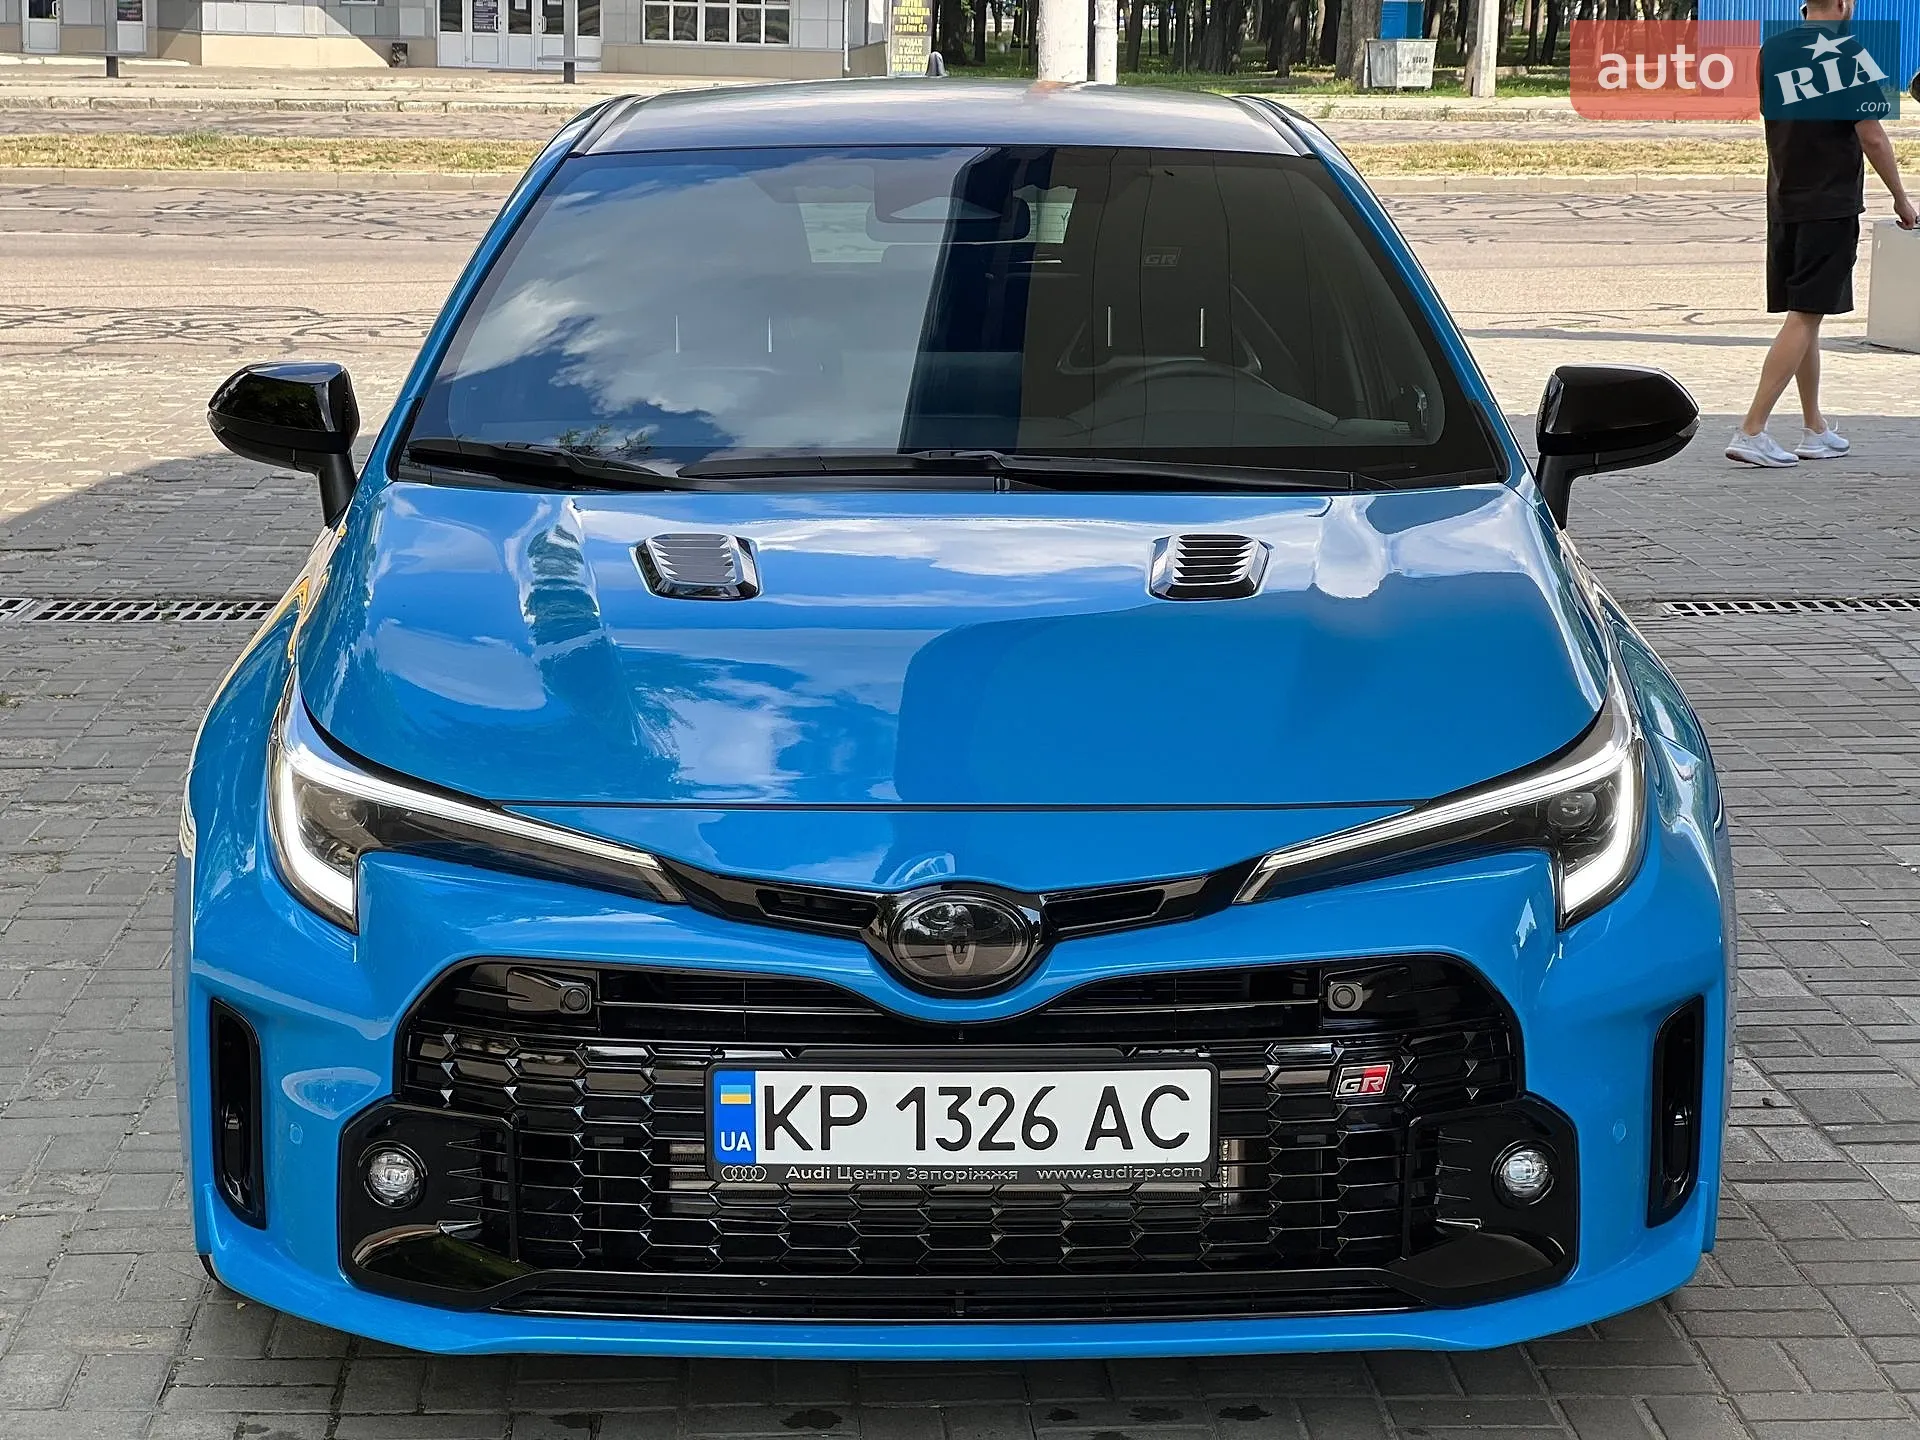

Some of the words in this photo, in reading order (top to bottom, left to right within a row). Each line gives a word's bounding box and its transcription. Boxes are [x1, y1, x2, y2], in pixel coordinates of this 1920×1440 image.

[1340, 1076, 1383, 1093] GR
[764, 1085, 868, 1151] KP
[896, 1085, 1059, 1151] 1326
[1084, 1084, 1190, 1151] AC
[720, 1131, 752, 1151] UA
[785, 1165, 830, 1180] Audi
[837, 1166, 901, 1183] Центр
[906, 1166, 1018, 1183] Запоріжжя
[1036, 1165, 1203, 1182] www.audizp.com
